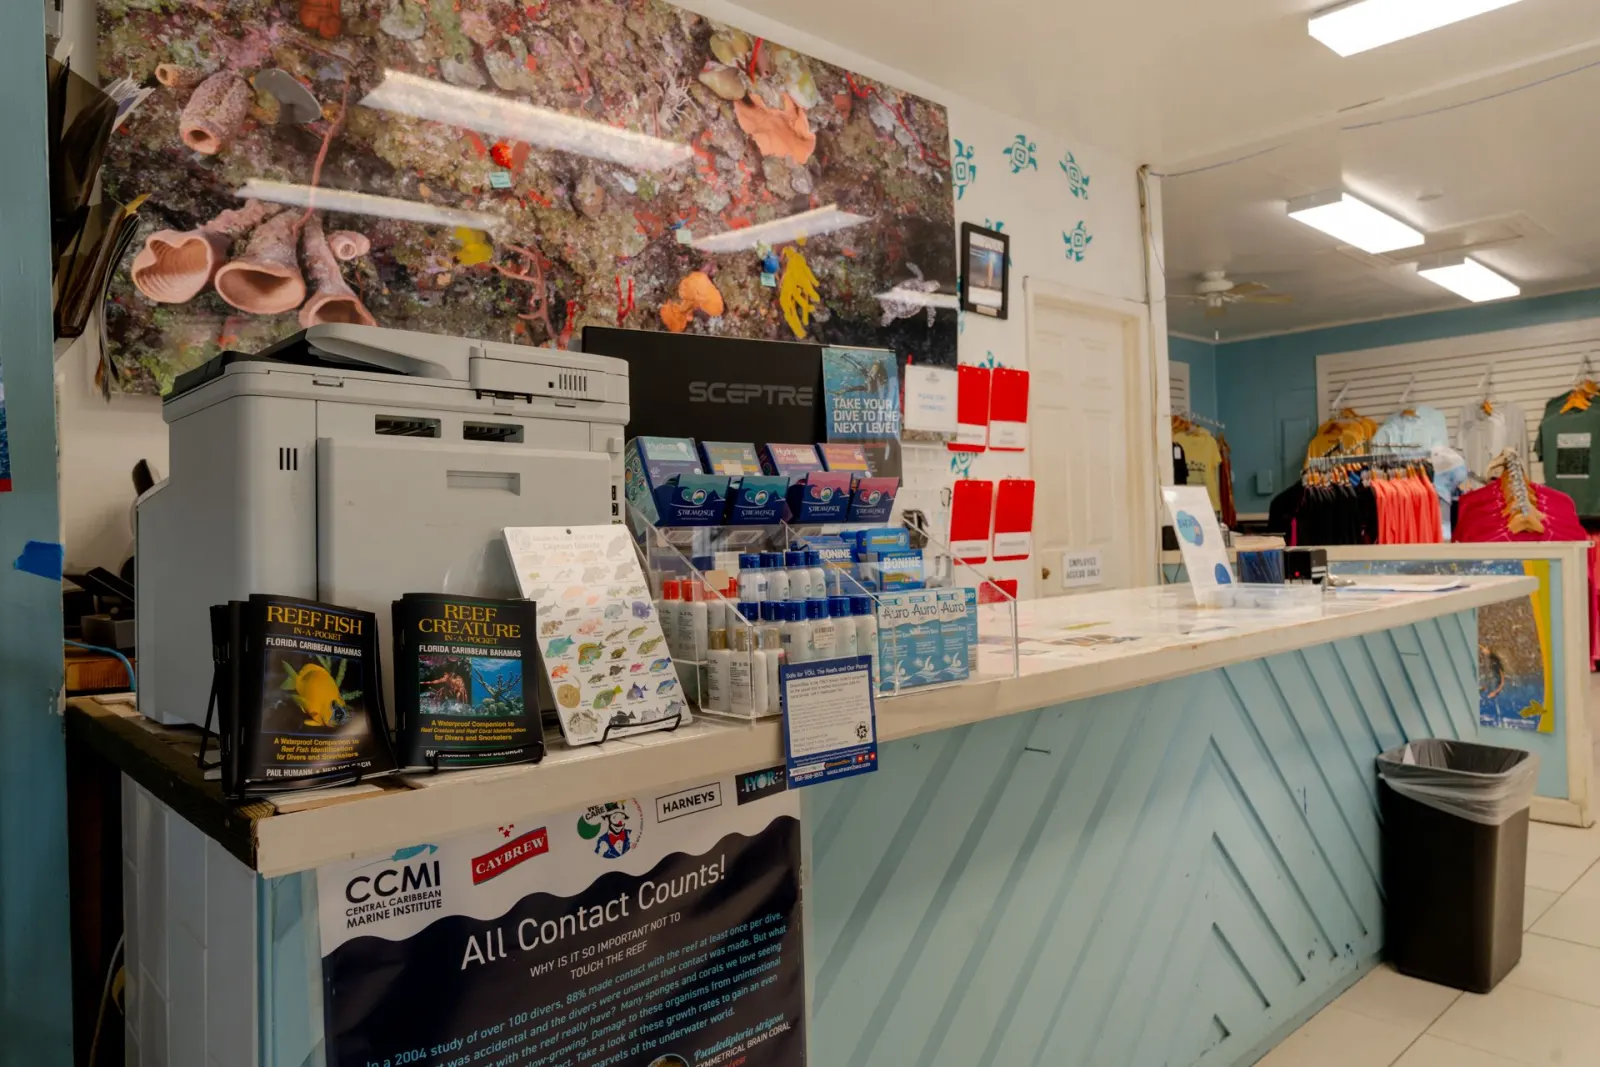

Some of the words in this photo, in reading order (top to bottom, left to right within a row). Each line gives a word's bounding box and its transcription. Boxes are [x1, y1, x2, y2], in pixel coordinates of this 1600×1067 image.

[689, 381, 813, 406] SCEPTRE
[833, 398, 860, 409] TAKE
[863, 398, 892, 409] YOUR
[833, 410, 860, 421] DIVE
[861, 410, 876, 421] TO
[877, 410, 899, 421] THE
[834, 422, 863, 433] NEXT
[866, 422, 898, 433] LEVEL
[819, 549, 852, 559] BONINE
[883, 557, 921, 570] BONINE
[444, 604, 497, 622] REEF
[883, 607, 910, 620] Auro
[912, 603, 937, 616] Auro
[940, 601, 966, 613] Auro
[266, 606, 321, 628] REEF
[324, 613, 363, 635] FISH
[418, 619, 521, 638] CREATURE
[266, 637, 297, 648] FLORIDA
[299, 641, 332, 653] CARIBBEAN
[333, 647, 362, 657] BAHAMAS
[419, 645, 449, 653] FLORIDA
[451, 646, 488, 656] CARIBBEAN
[490, 648, 522, 657] BAHAMAS
[438, 720, 471, 728] Waterproof
[471, 720, 507, 728] Companion
[280, 738, 313, 746] Waterproof
[286, 753, 307, 761] Divers
[321, 751, 359, 760] Snorkelers
[266, 769, 282, 777] PAUL
[283, 768, 313, 777] HUMANN
[585, 806, 605, 820] CARE
[663, 791, 715, 814] HARNEYS
[476, 837, 544, 874] CAYBREW
[345, 860, 441, 904] CCMI
[345, 900, 387, 917] CENTRAL
[389, 889, 442, 907] CARIBBEAN
[460, 927, 507, 971] All
[517, 892, 629, 951] Contact
[638, 855, 725, 910] Counts!
[346, 909, 391, 929] MARINE
[393, 899, 442, 917] INSTITUTE
[530, 961, 554, 978] WHY
[558, 956, 568, 968] IS
[570, 951, 580, 963] IT
[582, 945, 595, 960] SO
[597, 925, 650, 953] IMPORTANT
[650, 917, 667, 931] NOT
[670, 912, 681, 924] TO
[570, 958, 604, 980] TOUCH
[605, 950, 624, 966] THE
[626, 940, 648, 960] REEF
[394, 1048, 427, 1065] 2004
[430, 1037, 464, 1056] study
[480, 1022, 506, 1038] over
[509, 1012, 528, 1027] 100
[530, 999, 564, 1019] divers,
[566, 988, 587, 1004] 88%
[588, 979, 613, 995] made
[614, 965, 646, 984] contact
[648, 955, 665, 968] with
[666, 949, 680, 960] the
[681, 941, 699, 955] reef
[709, 930, 729, 946] least
[729, 925, 748, 936] once
[749, 918, 763, 933] per
[764, 912, 783, 924] dive.
[447, 1054, 471, 1067] was
[473, 1030, 527, 1061] accidental
[530, 1021, 549, 1036] and
[550, 1015, 567, 1028] the
[568, 1002, 597, 1020] divers
[599, 993, 621, 1006] were
[623, 975, 659, 995] unaware
[660, 966, 676, 979] that
[678, 954, 708, 971] contact
[709, 947, 725, 959] was
[727, 939, 751, 953] made.
[753, 932, 767, 943] But
[768, 925, 787, 938] what
[496, 1052, 518, 1067] with
[521, 1044, 537, 1058] the
[540, 1032, 559, 1049] reef
[561, 1022, 588, 1040] really
[589, 1007, 617, 1025] have?
[620, 996, 644, 1012] Many
[645, 982, 679, 1001] sponges
[681, 972, 697, 986] and
[698, 963, 724, 979] corals
[739, 952, 756, 964] love
[757, 942, 782, 957] seeing
[524, 1037, 589, 1067] low-growing.
[591, 1019, 627, 1040] Damage
[639, 1002, 663, 1018] these
[665, 987, 709, 1009] organisms
[711, 977, 731, 990] from
[732, 956, 781, 983] unintentional
[576, 1049, 597, 1062] Take
[607, 1034, 627, 1048] look
[639, 1017, 664, 1035] these
[666, 1006, 697, 1026] growth
[698, 998, 720, 1012] rates
[731, 988, 749, 1001] gain
[760, 974, 778, 987] even
[591, 1050, 629, 1067] marvels
[642, 1037, 657, 1050] the
[659, 1018, 709, 1043] underwater
[710, 1007, 735, 1024] world.
[747, 1032, 768, 1048] BRAIN
[768, 1022, 791, 1037] CORAL
